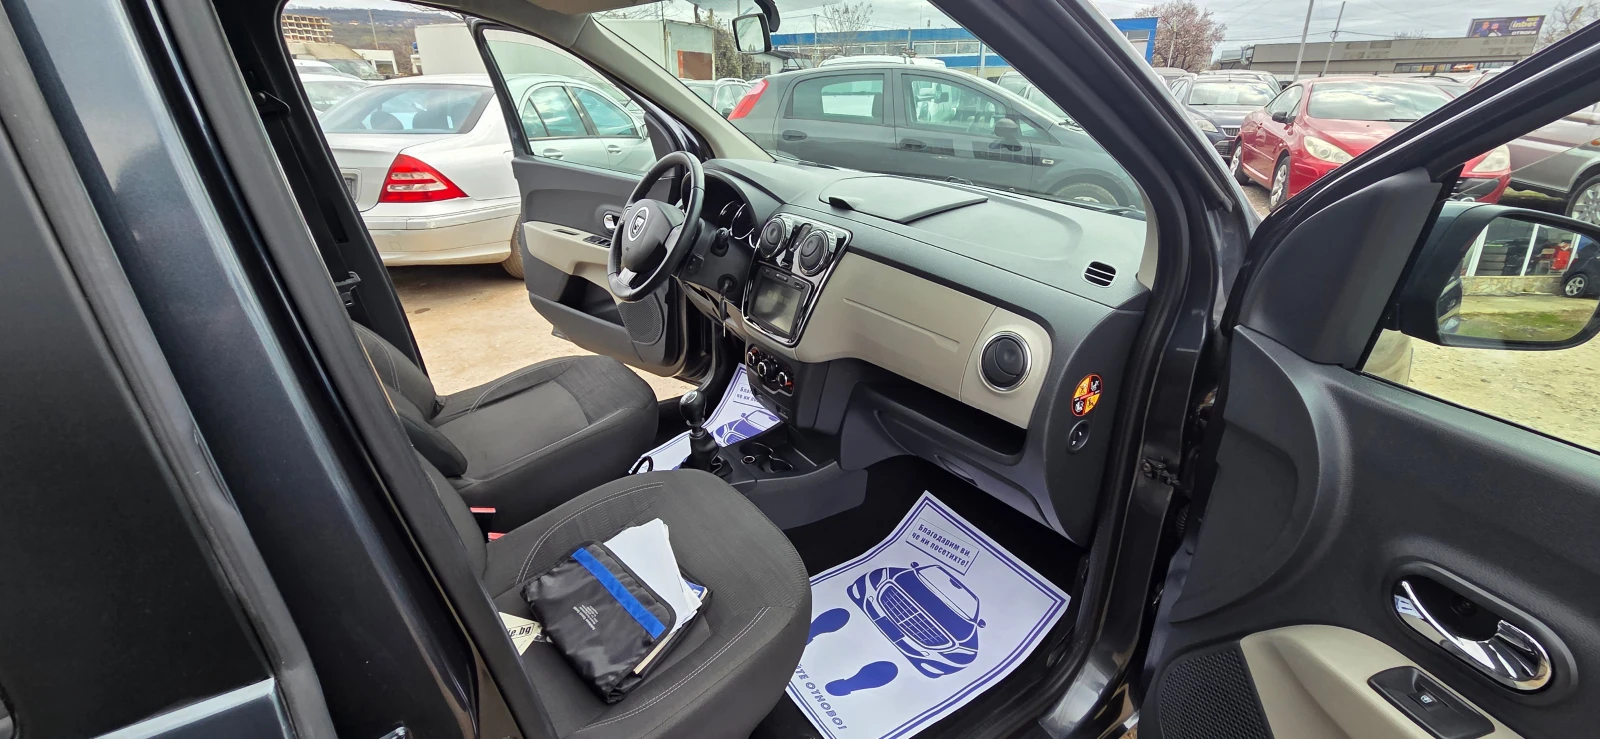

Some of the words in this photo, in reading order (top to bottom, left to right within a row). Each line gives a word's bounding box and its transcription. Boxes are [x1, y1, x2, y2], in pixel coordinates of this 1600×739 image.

[1512, 20, 1537, 28] inbet
[911, 532, 921, 541] че
[920, 537, 930, 546] ни
[930, 542, 970, 568] посетихте!
[918, 524, 960, 551] Благодарим
